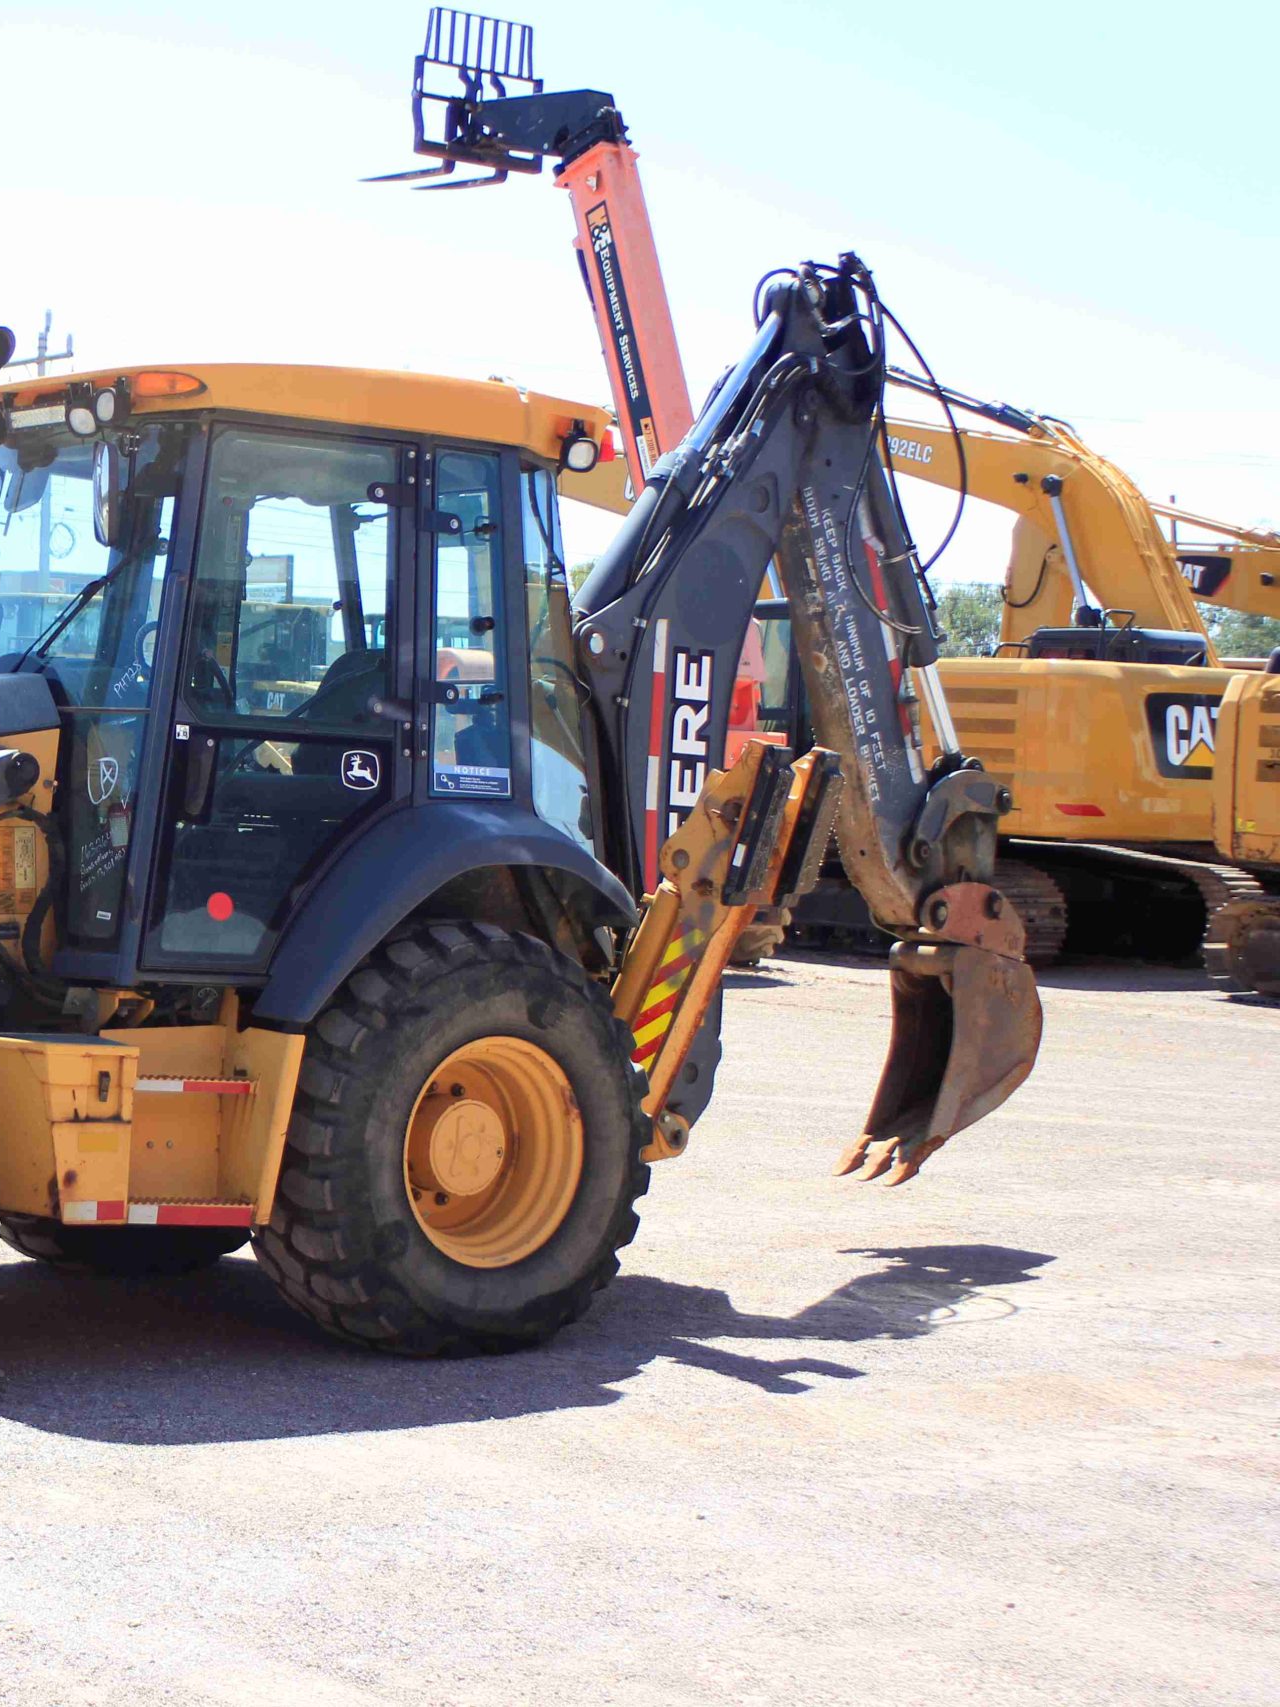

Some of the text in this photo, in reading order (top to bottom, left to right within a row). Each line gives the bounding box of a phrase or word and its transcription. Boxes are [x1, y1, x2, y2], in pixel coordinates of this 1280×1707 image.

[803, 486, 821, 528] BOOM
[815, 537, 832, 582] SWING
[837, 640, 851, 669] AND
[845, 677, 866, 736] LOADER
[821, 507, 838, 548] KEEP
[832, 553, 847, 593] BACK
[859, 679, 872, 699] OF
[266, 691, 286, 711] CAT
[453, 766, 491, 776] NOTICE
